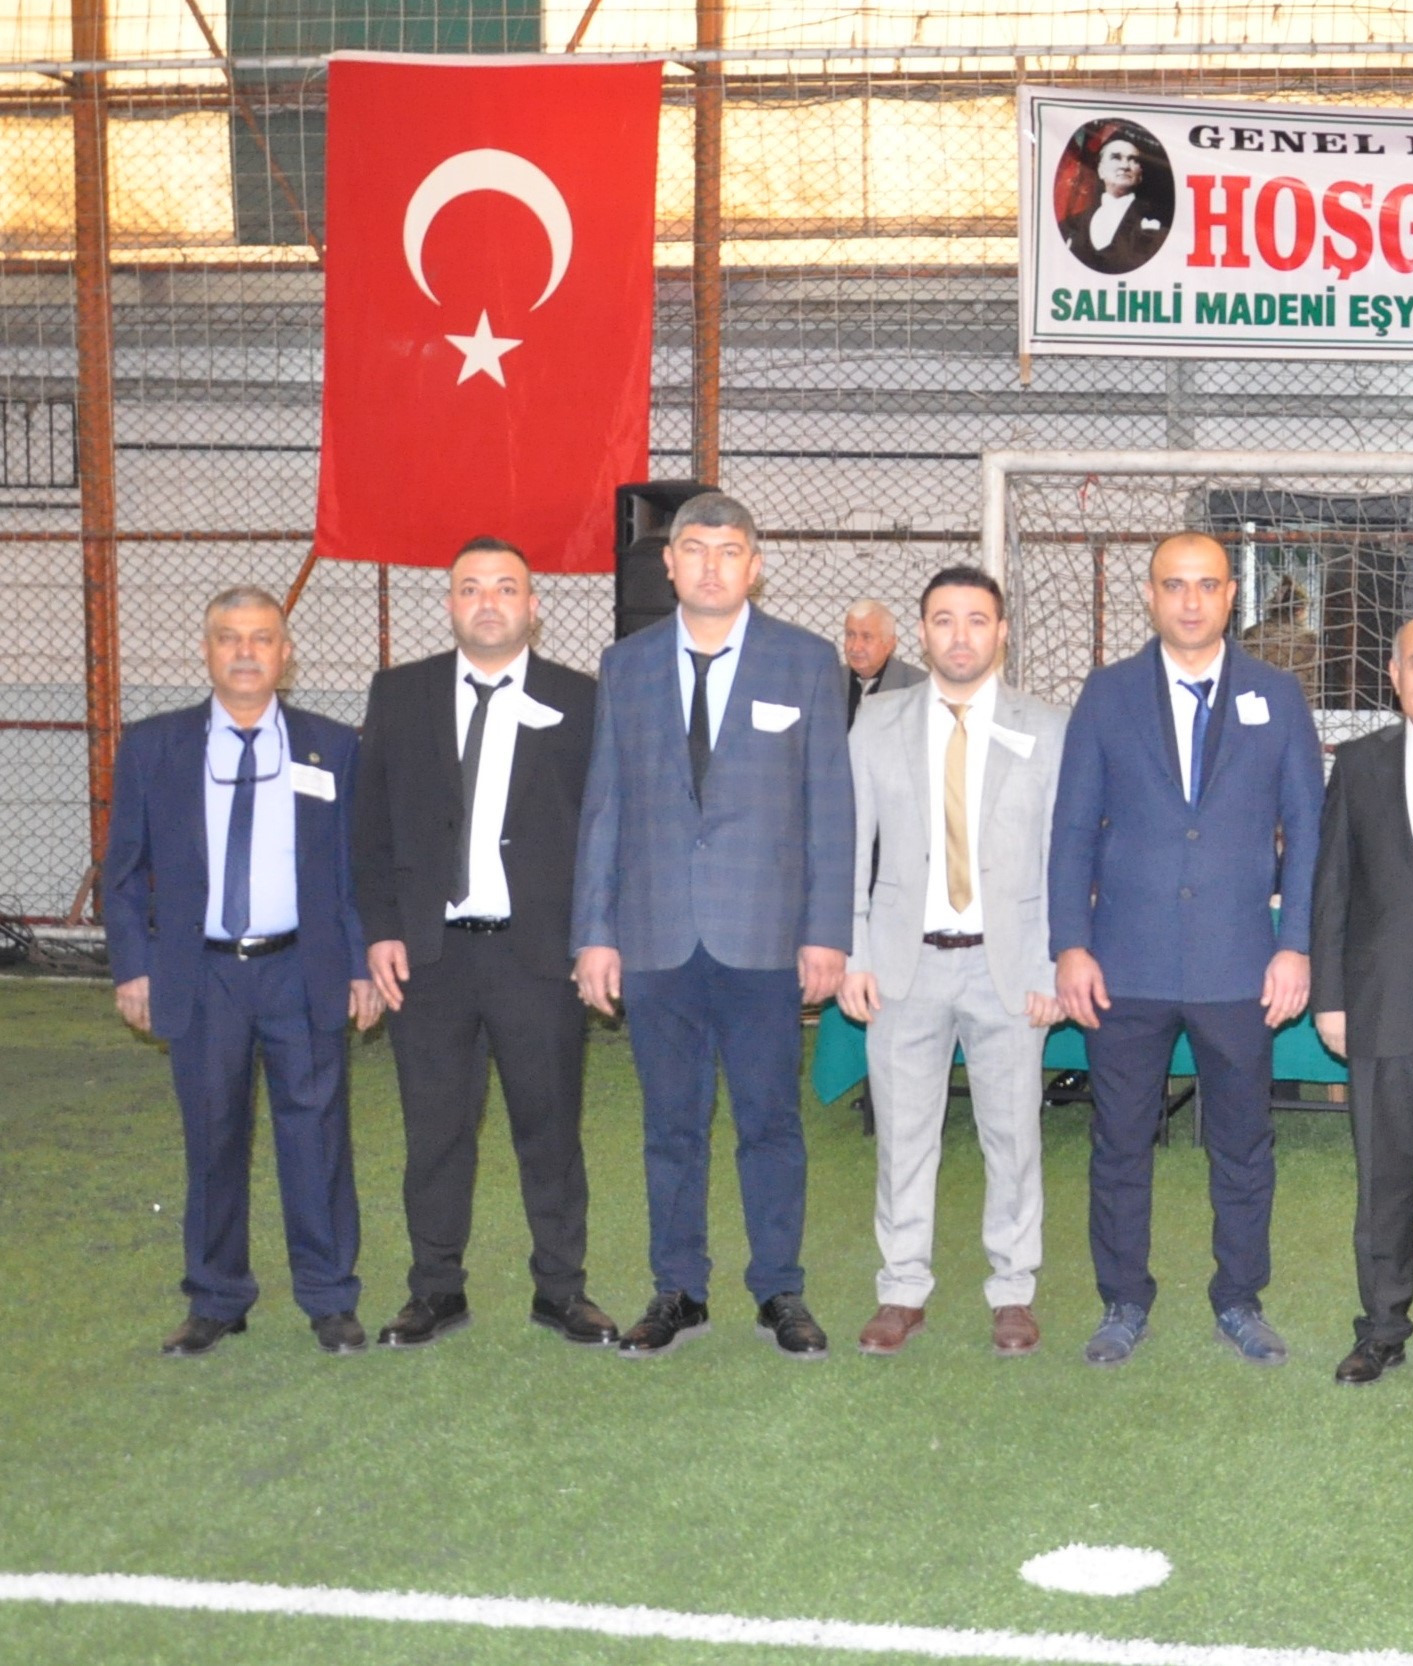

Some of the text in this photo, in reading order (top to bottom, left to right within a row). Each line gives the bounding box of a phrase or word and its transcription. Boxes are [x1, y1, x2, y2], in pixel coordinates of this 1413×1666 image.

[1188, 124, 1385, 155] GENEL
[1050, 281, 1182, 325] SALİHLİ
[1195, 286, 1336, 327] MADENİ
